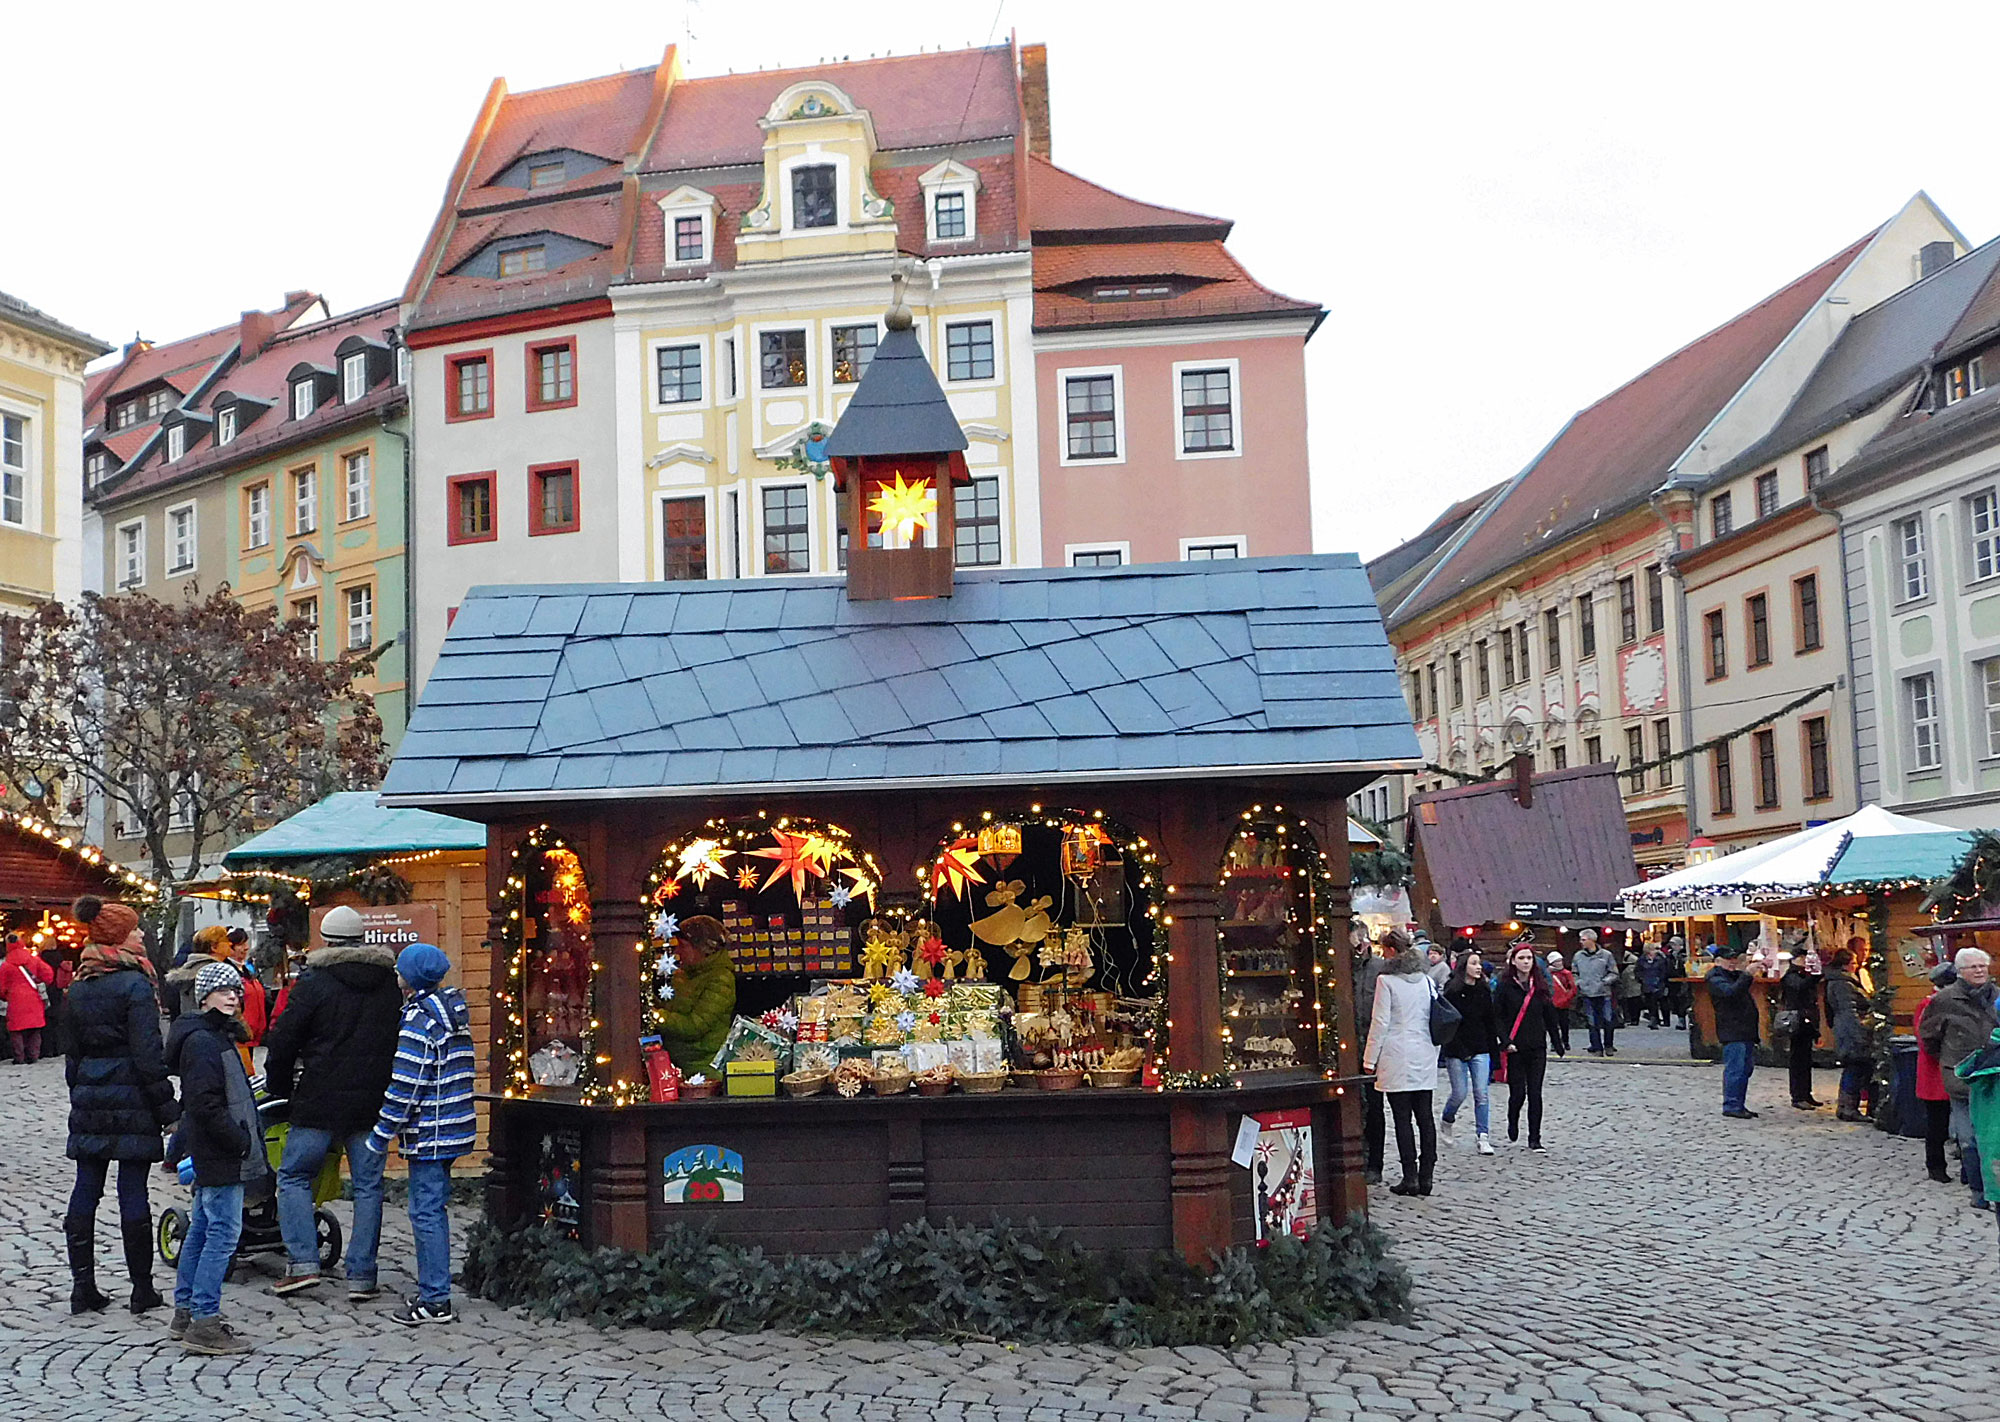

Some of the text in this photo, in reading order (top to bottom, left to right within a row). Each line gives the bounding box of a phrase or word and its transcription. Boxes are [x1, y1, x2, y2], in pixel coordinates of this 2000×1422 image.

[1631, 898, 1713, 916] Pfannengerichte
[364, 928, 418, 944] Hirche
[689, 1181, 721, 1199] 20
